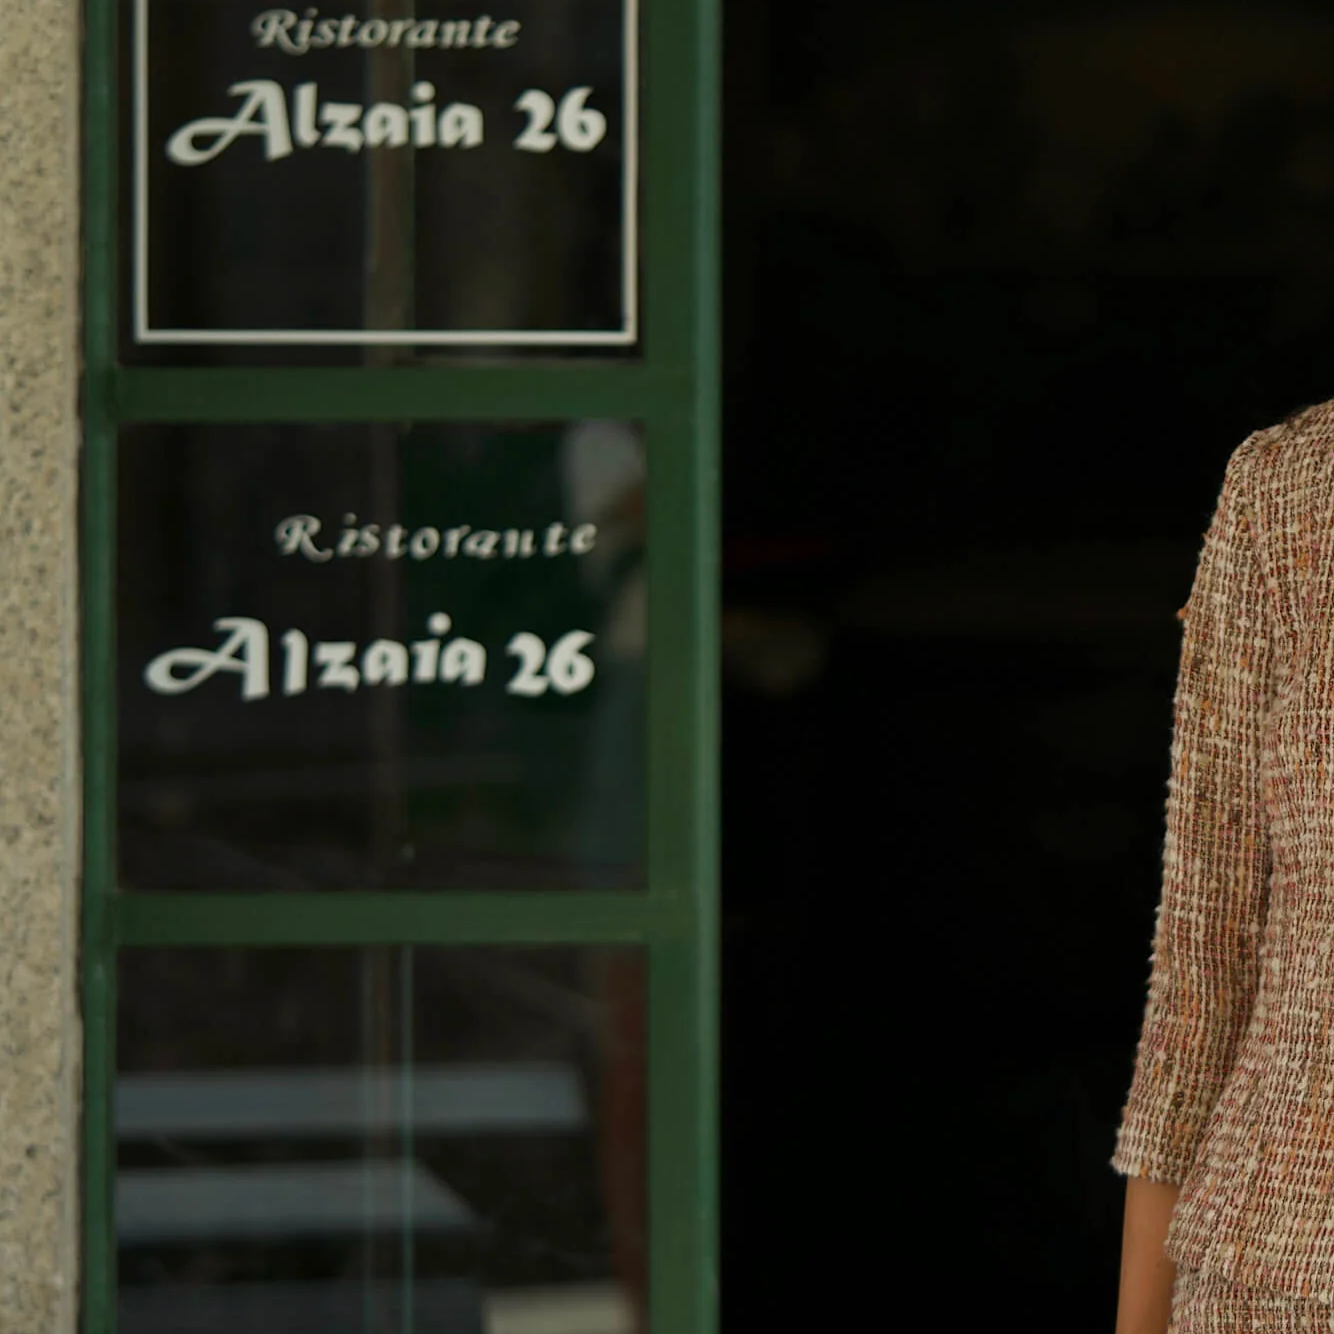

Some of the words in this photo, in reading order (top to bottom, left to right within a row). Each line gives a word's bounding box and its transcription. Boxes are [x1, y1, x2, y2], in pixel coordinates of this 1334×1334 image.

[251, 7, 521, 55] Ristorante
[166, 79, 484, 165] Alzaia
[513, 86, 607, 152] 26
[275, 512, 598, 562] Ristorante
[144, 611, 487, 701] Alzaia
[506, 629, 596, 697] 26
